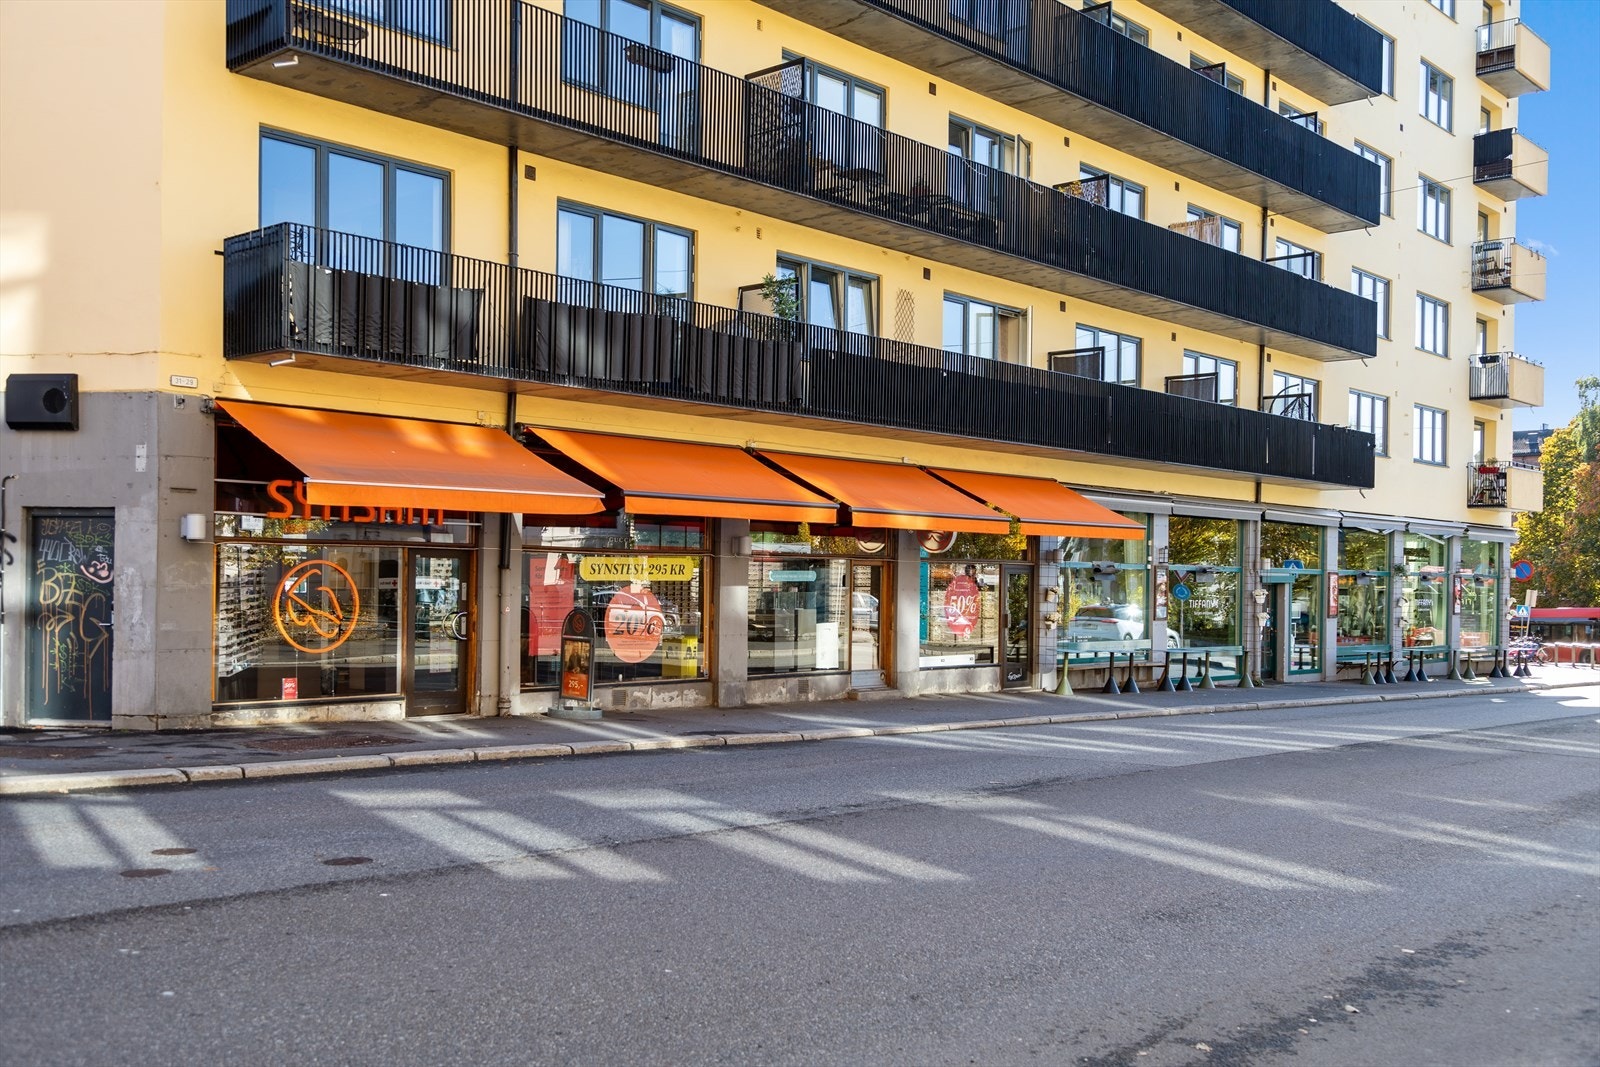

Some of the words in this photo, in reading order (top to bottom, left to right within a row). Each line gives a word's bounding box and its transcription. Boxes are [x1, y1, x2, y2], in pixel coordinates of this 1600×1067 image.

[589, 563, 647, 576] SYNSTEST
[648, 563, 668, 575] 295
[669, 564, 686, 576] KR
[949, 594, 977, 614] 50%
